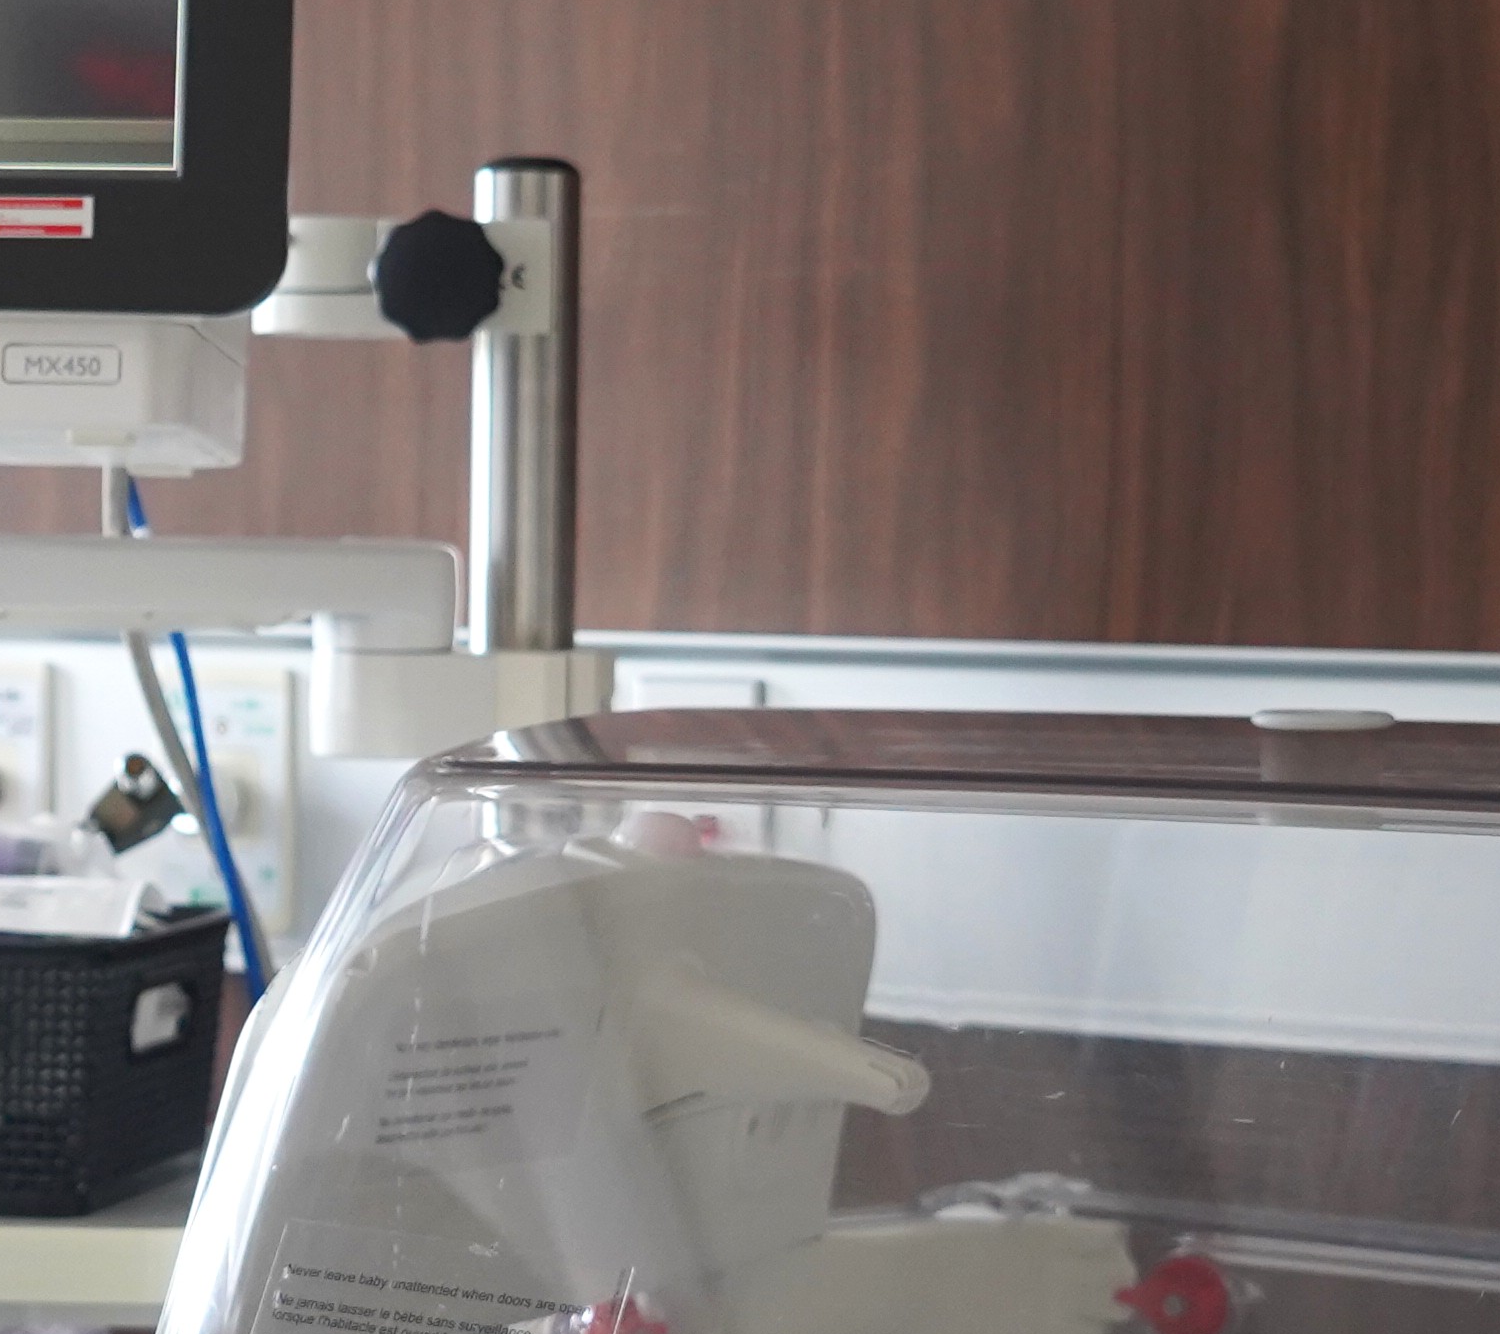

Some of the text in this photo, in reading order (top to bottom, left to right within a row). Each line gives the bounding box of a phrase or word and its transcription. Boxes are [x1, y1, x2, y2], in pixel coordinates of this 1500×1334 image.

[24, 355, 101, 377] MX450
[287, 1263, 322, 1278] Never
[324, 1269, 355, 1284] leave
[359, 1272, 388, 1291] baby
[392, 1278, 459, 1298] unattended
[461, 1288, 494, 1303] when
[497, 1292, 532, 1308] doors
[535, 1299, 556, 1311] are
[272, 1308, 315, 1327] lorsque
[279, 1291, 293, 1306] Ne
[294, 1297, 335, 1312] jamais
[337, 1303, 377, 1318] laisser
[379, 1307, 391, 1319] le
[426, 1315, 455, 1330] sans
